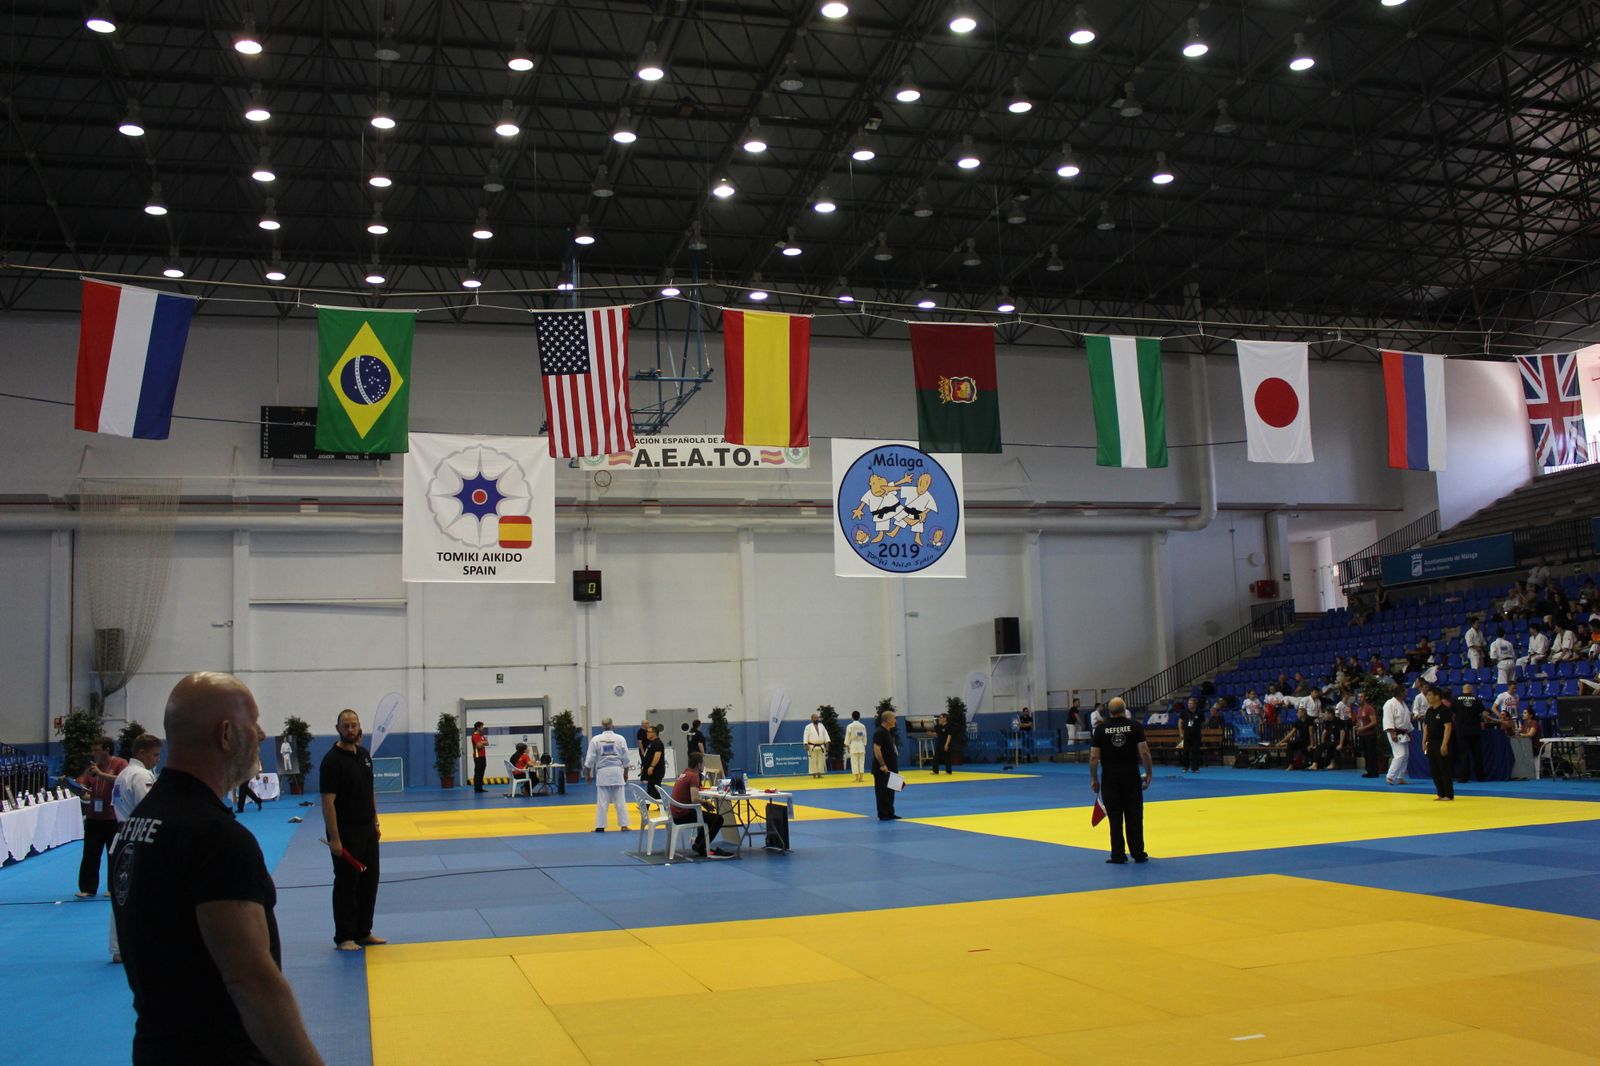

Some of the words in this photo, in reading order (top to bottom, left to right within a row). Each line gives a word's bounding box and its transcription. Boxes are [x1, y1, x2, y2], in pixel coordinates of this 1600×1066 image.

[635, 436, 660, 444] ACIÓN
[662, 436, 706, 444] ESPAÑOLA
[634, 447, 759, 468] A.E.A.TO.
[872, 453, 924, 471] Málaga
[878, 543, 920, 558] 2019
[436, 552, 479, 562] TOMIKI
[482, 552, 523, 562] AIKIDO
[463, 566, 496, 575] SPAIN
[588, 582, 596, 594] 0
[1105, 725, 1131, 734] REFEREE
